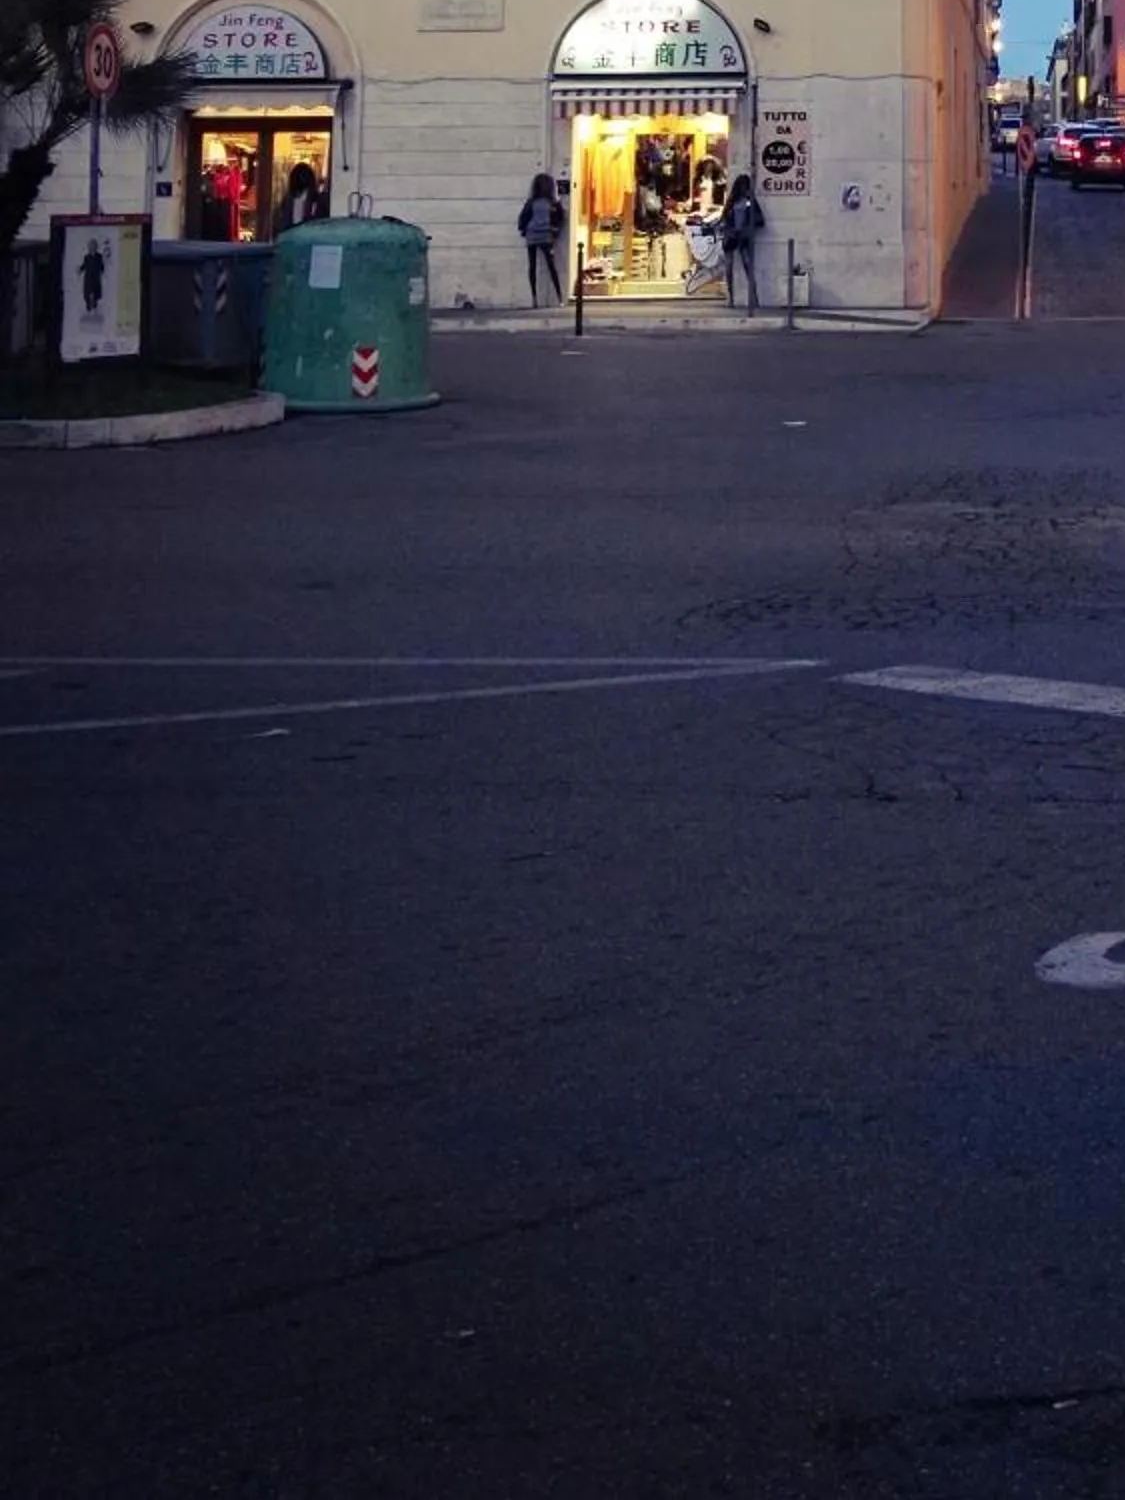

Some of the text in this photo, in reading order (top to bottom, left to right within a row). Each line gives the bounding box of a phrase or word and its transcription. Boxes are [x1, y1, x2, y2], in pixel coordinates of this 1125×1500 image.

[218, 13, 285, 31] Jin Feng
[202, 33, 299, 49] STORE
[94, 43, 113, 79] 30
[763, 111, 807, 122] TUTTO
[776, 125, 792, 135] DA
